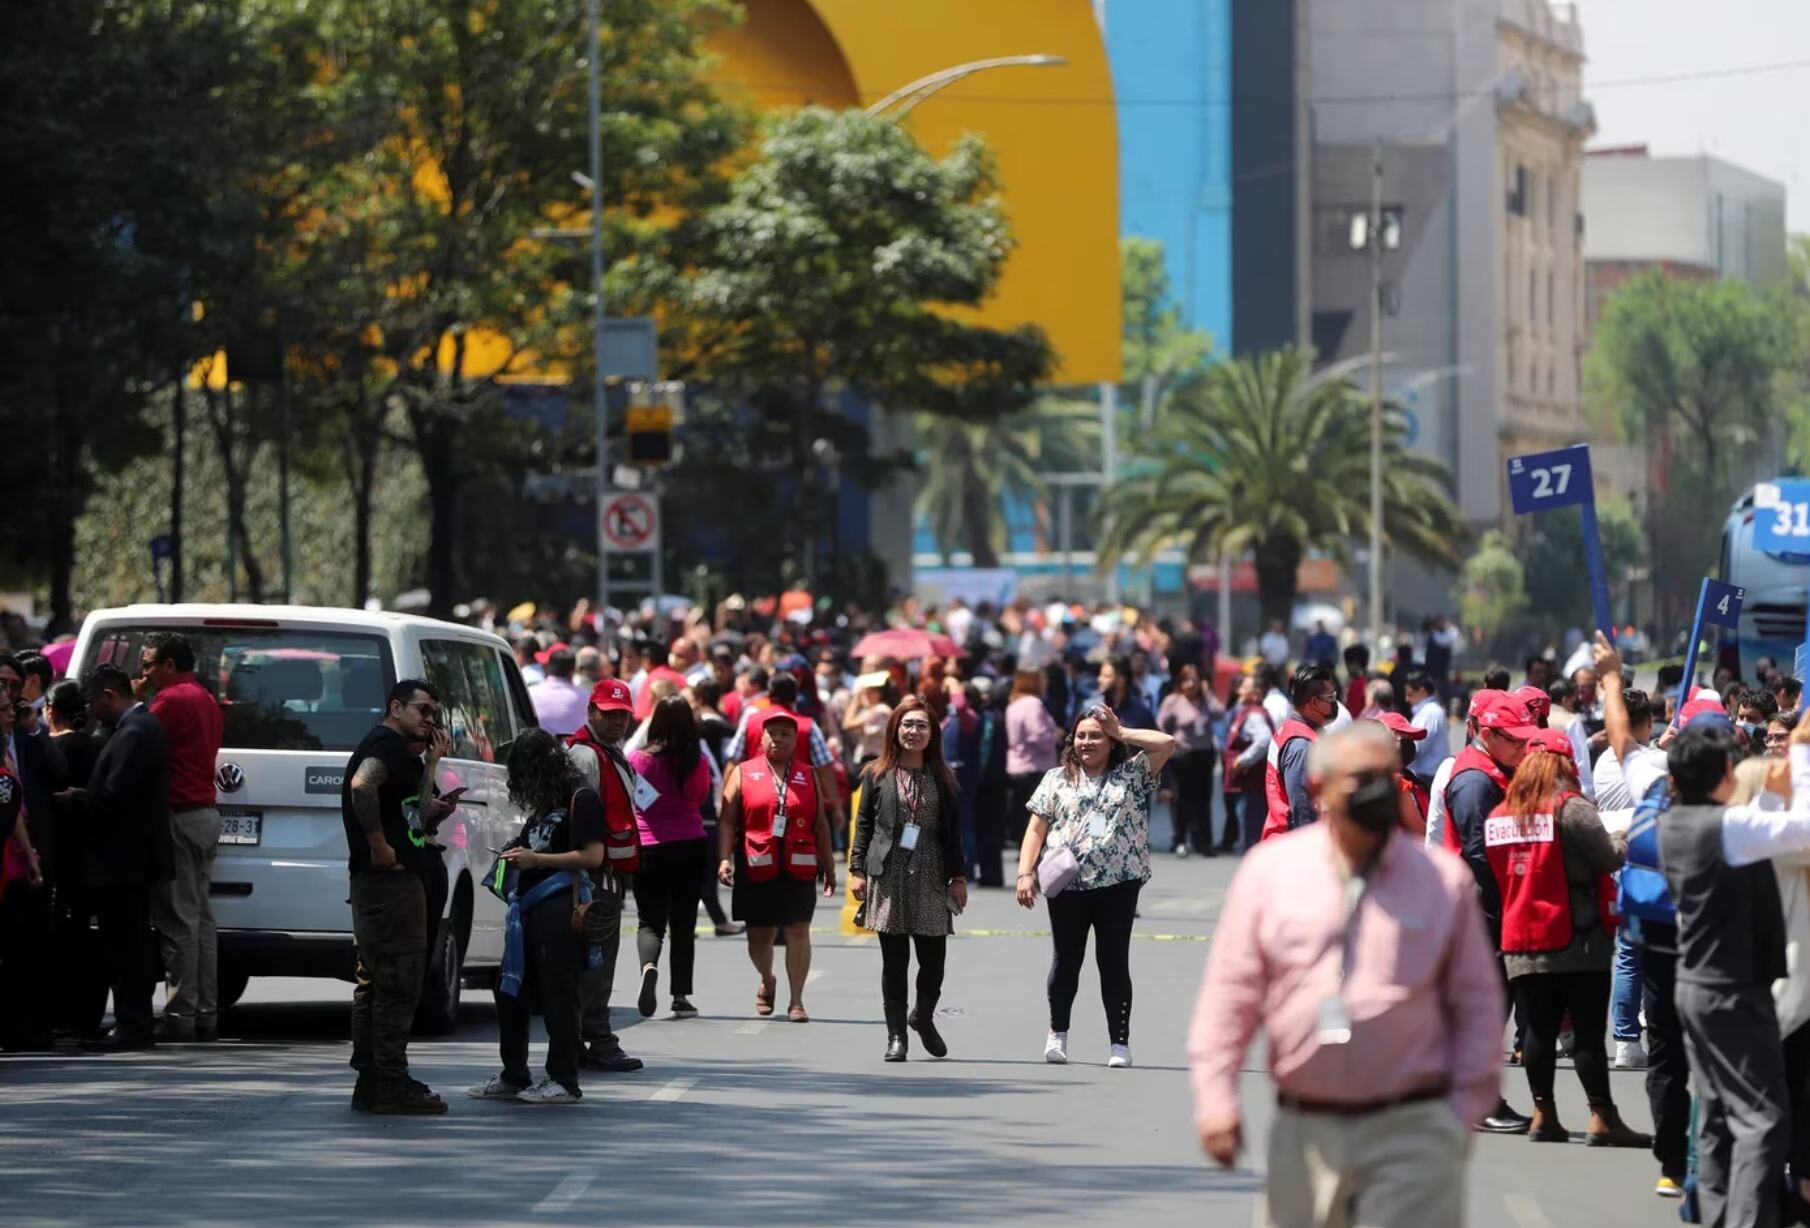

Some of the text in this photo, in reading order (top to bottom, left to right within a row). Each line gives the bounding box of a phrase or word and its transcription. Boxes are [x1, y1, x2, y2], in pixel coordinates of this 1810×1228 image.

[1531, 464, 1571, 498] 27
[1772, 502, 1810, 536] 31
[1717, 595, 1729, 615] 4
